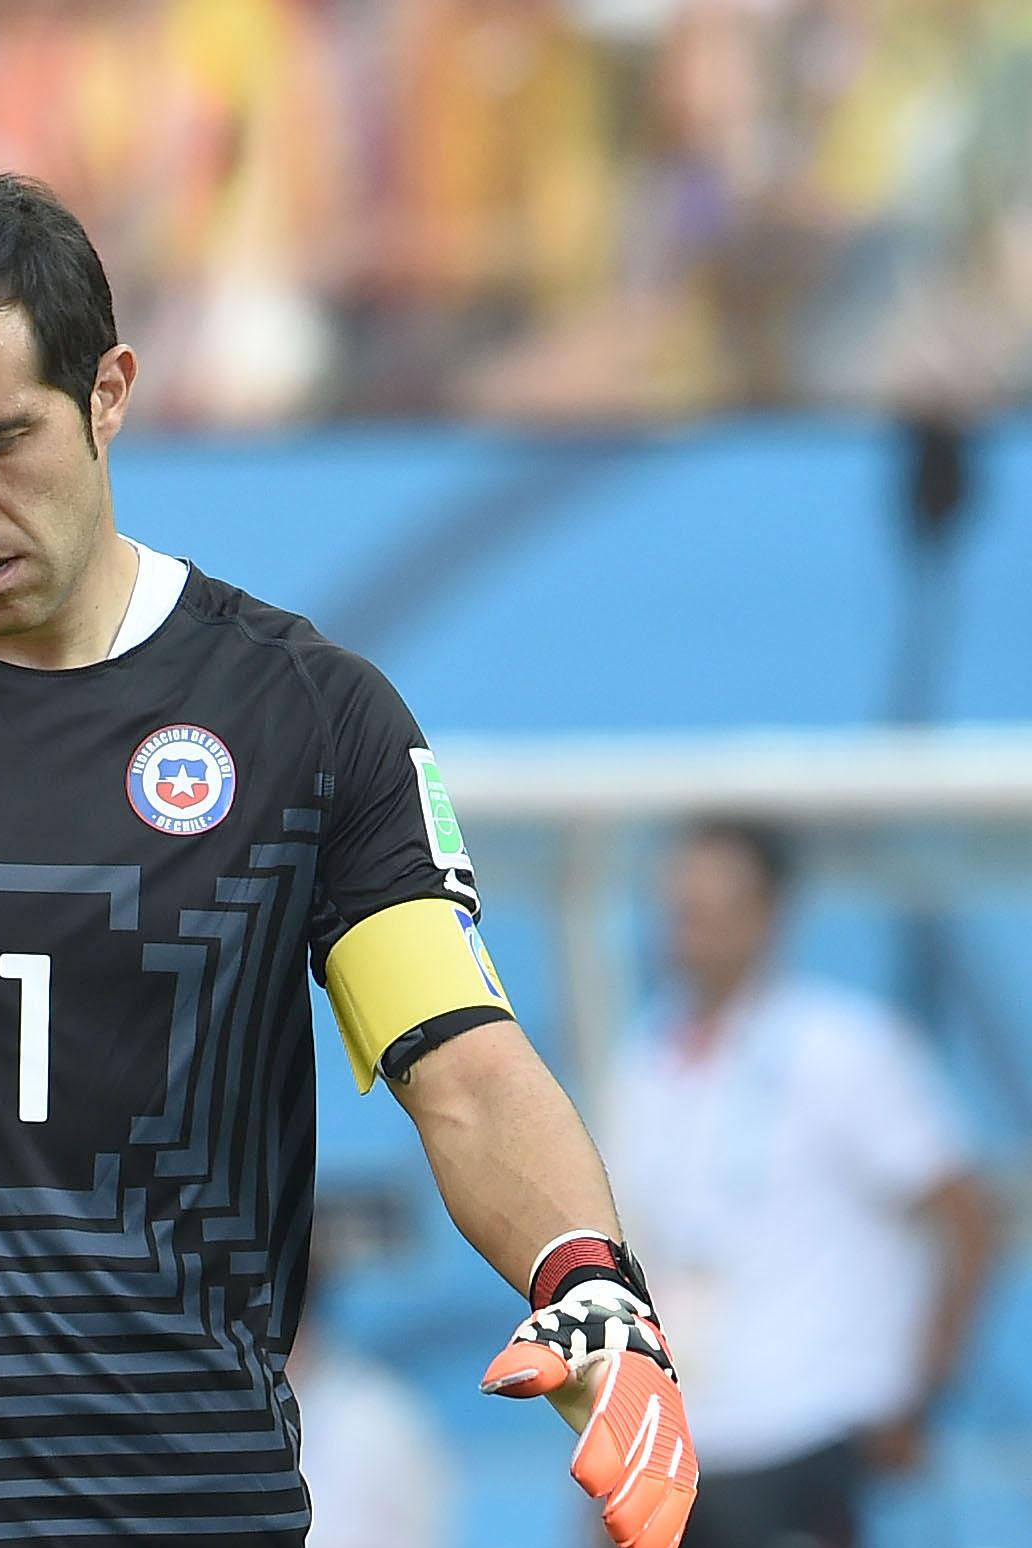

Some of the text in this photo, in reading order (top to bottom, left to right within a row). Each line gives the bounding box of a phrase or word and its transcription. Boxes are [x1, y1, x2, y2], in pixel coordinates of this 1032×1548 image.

[132, 728, 233, 779] FEDERACION DE FUTBOL
[155, 816, 208, 832] DE CHILE
